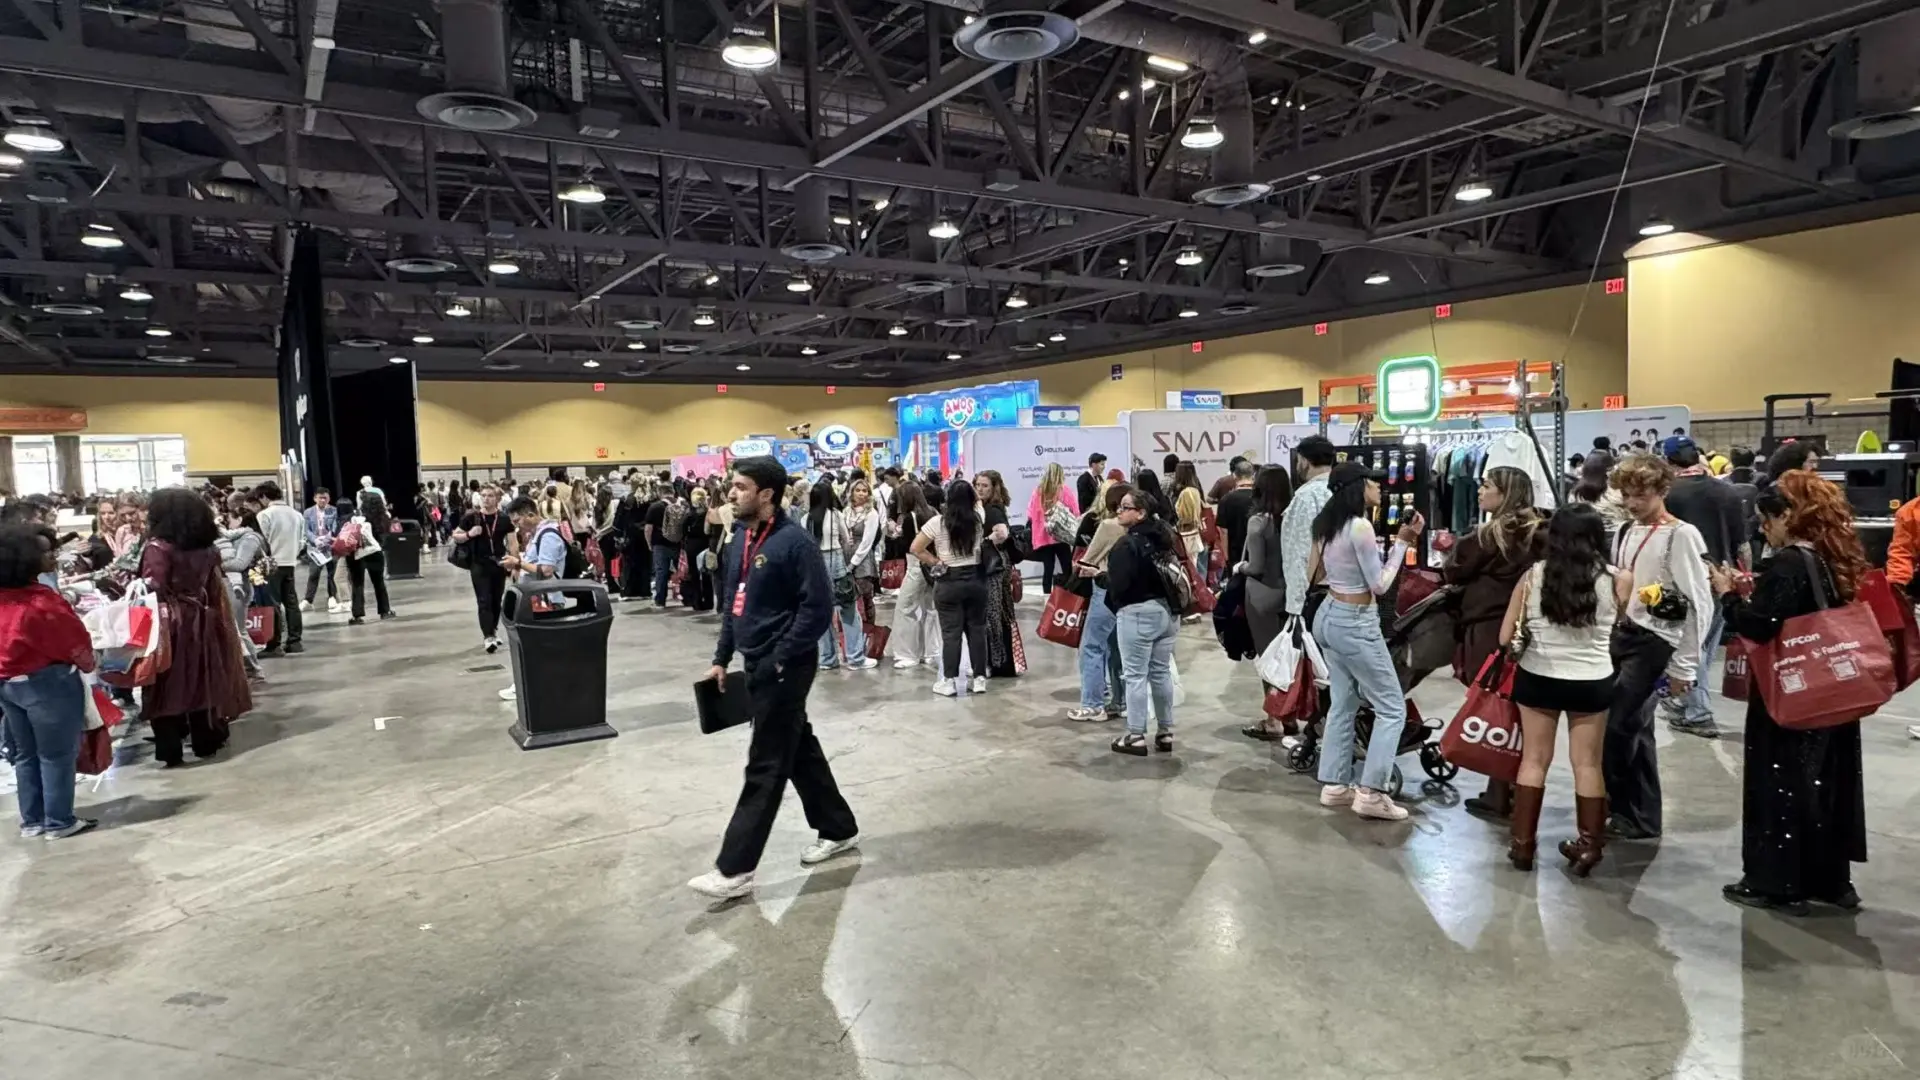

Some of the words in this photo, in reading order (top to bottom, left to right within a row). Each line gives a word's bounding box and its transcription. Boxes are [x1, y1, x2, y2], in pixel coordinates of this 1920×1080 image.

[1607, 280, 1622, 292] EXIT
[945, 398, 975, 416] AMOS
[1195, 396, 1219, 405] SNAP
[1152, 431, 1236, 453] SNAP
[244, 615, 264, 629] oli
[1782, 633, 1821, 648] YFCon
[1726, 654, 1748, 675] oli
